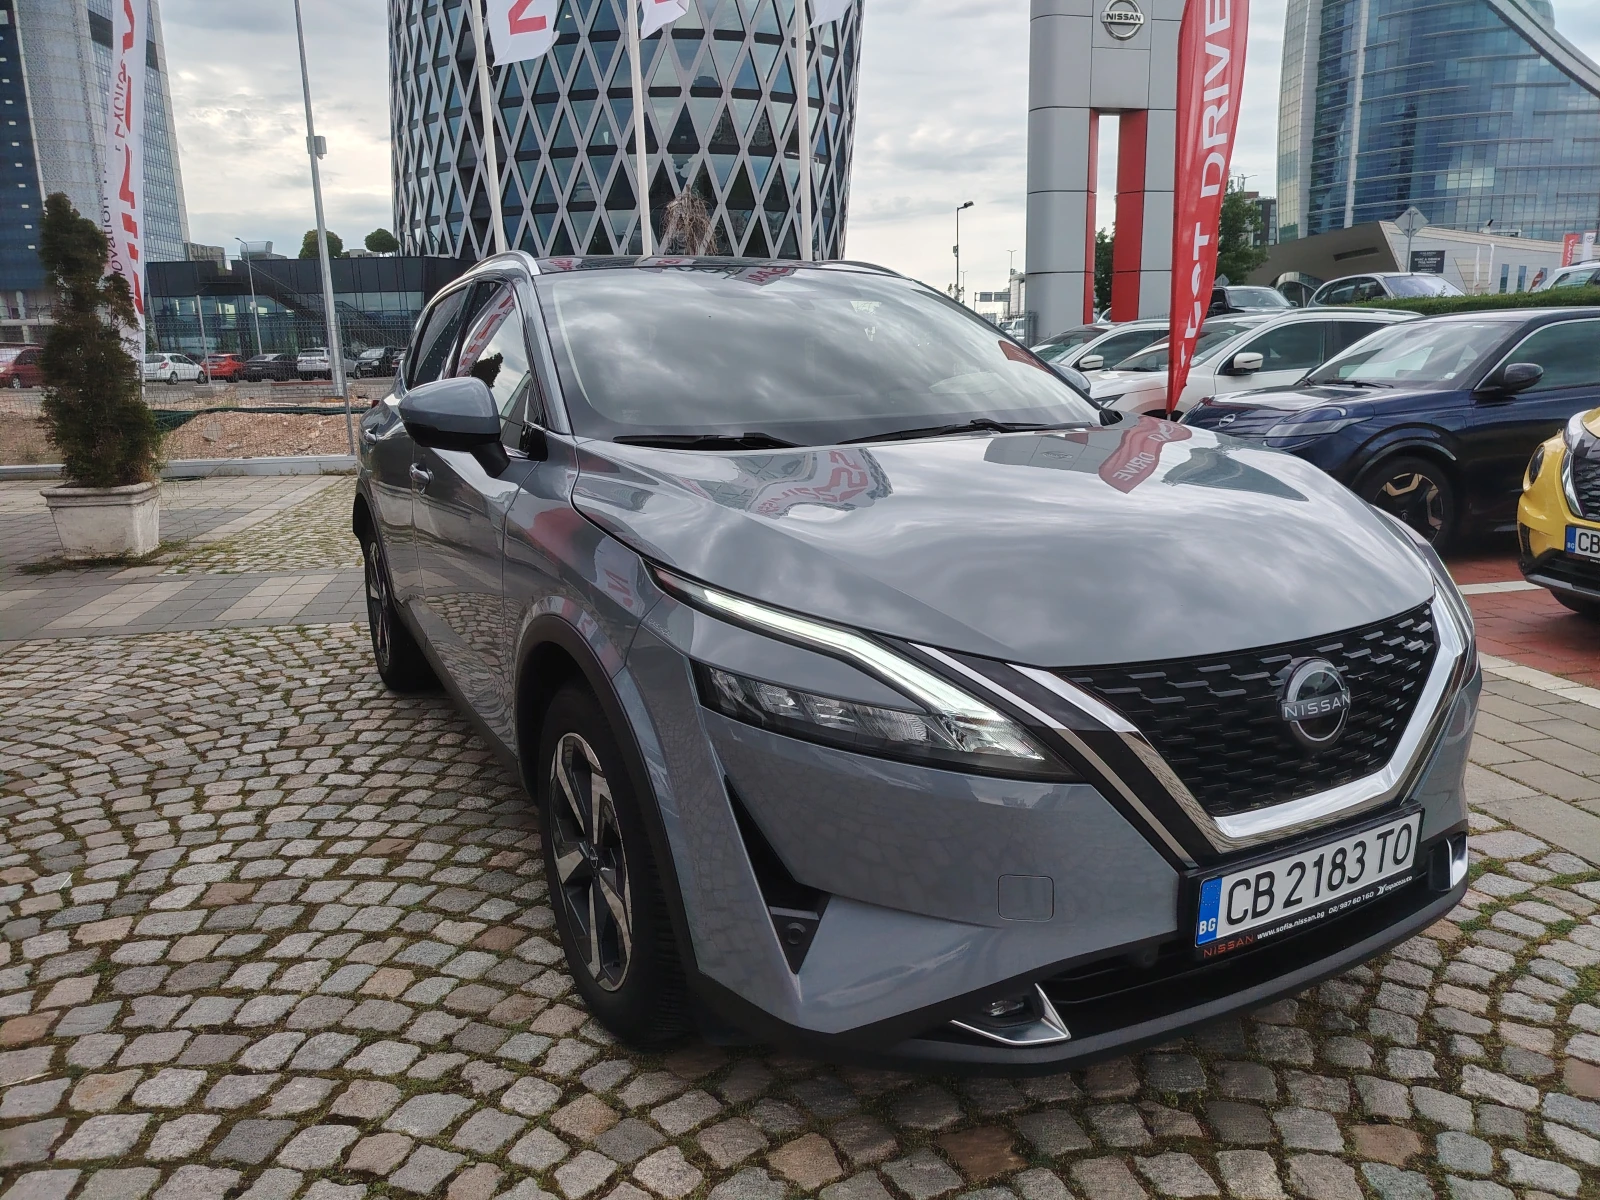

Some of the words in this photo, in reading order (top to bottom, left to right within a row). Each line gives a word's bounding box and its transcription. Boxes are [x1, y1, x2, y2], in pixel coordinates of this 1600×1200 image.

[1106, 12, 1141, 22] NISSAN
[1200, 0, 1230, 198] DRIVE
[1284, 694, 1350, 718] NISSAN
[1226, 870, 1275, 925] CB
[1283, 840, 1366, 908] 2183
[1377, 823, 1412, 873] TO
[1199, 918, 1216, 935] BG
[1203, 934, 1254, 958] NISSAN
[1257, 910, 1325, 940] www.sofia.nissan.bg
